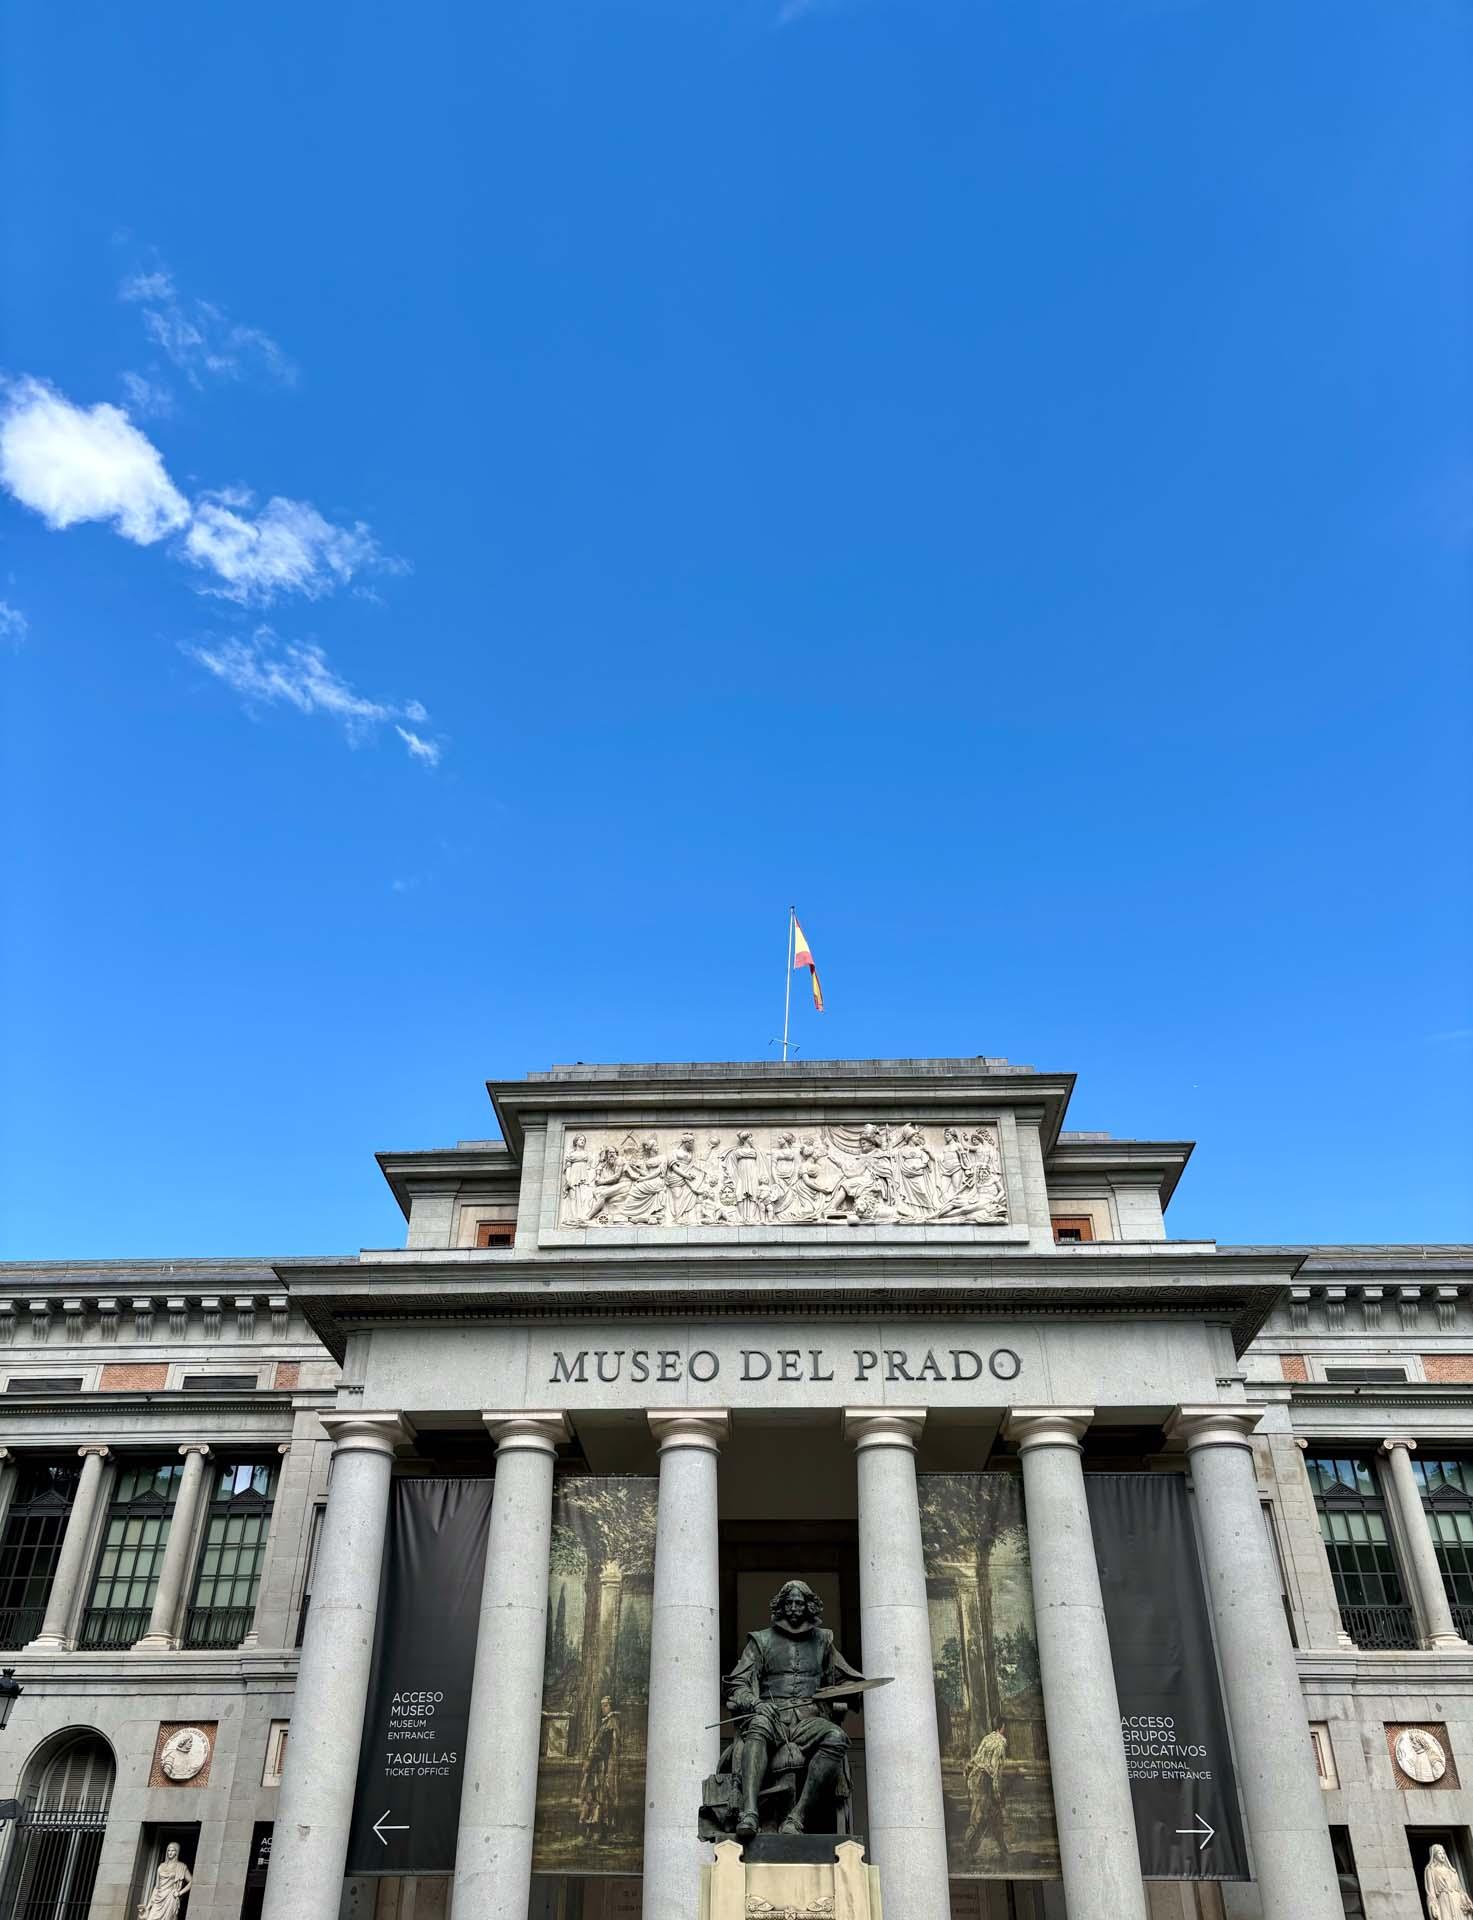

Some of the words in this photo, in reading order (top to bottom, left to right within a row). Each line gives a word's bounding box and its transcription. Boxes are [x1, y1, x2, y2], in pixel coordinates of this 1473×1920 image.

[549, 1350, 720, 1382] MUSEO
[740, 1349, 834, 1381] DEL
[853, 1348, 1022, 1381] PRADO
[392, 1691, 444, 1703] ACCESO
[391, 1704, 435, 1716] MUSEO
[389, 1719, 427, 1728] MUSEUM
[1120, 1716, 1174, 1728] ACCESO
[387, 1730, 436, 1740] ENTRANCE
[1122, 1730, 1176, 1742] GRUPOS
[1124, 1744, 1207, 1756] EDUCATIVOS
[386, 1752, 457, 1765] TAQUILLAS
[385, 1767, 415, 1776] TICKET
[417, 1766, 450, 1776] OFFICE
[1125, 1760, 1190, 1770] EDUCATIONAL
[1127, 1770, 1159, 1779] GROUP
[1162, 1771, 1213, 1780] ENTRANCE
